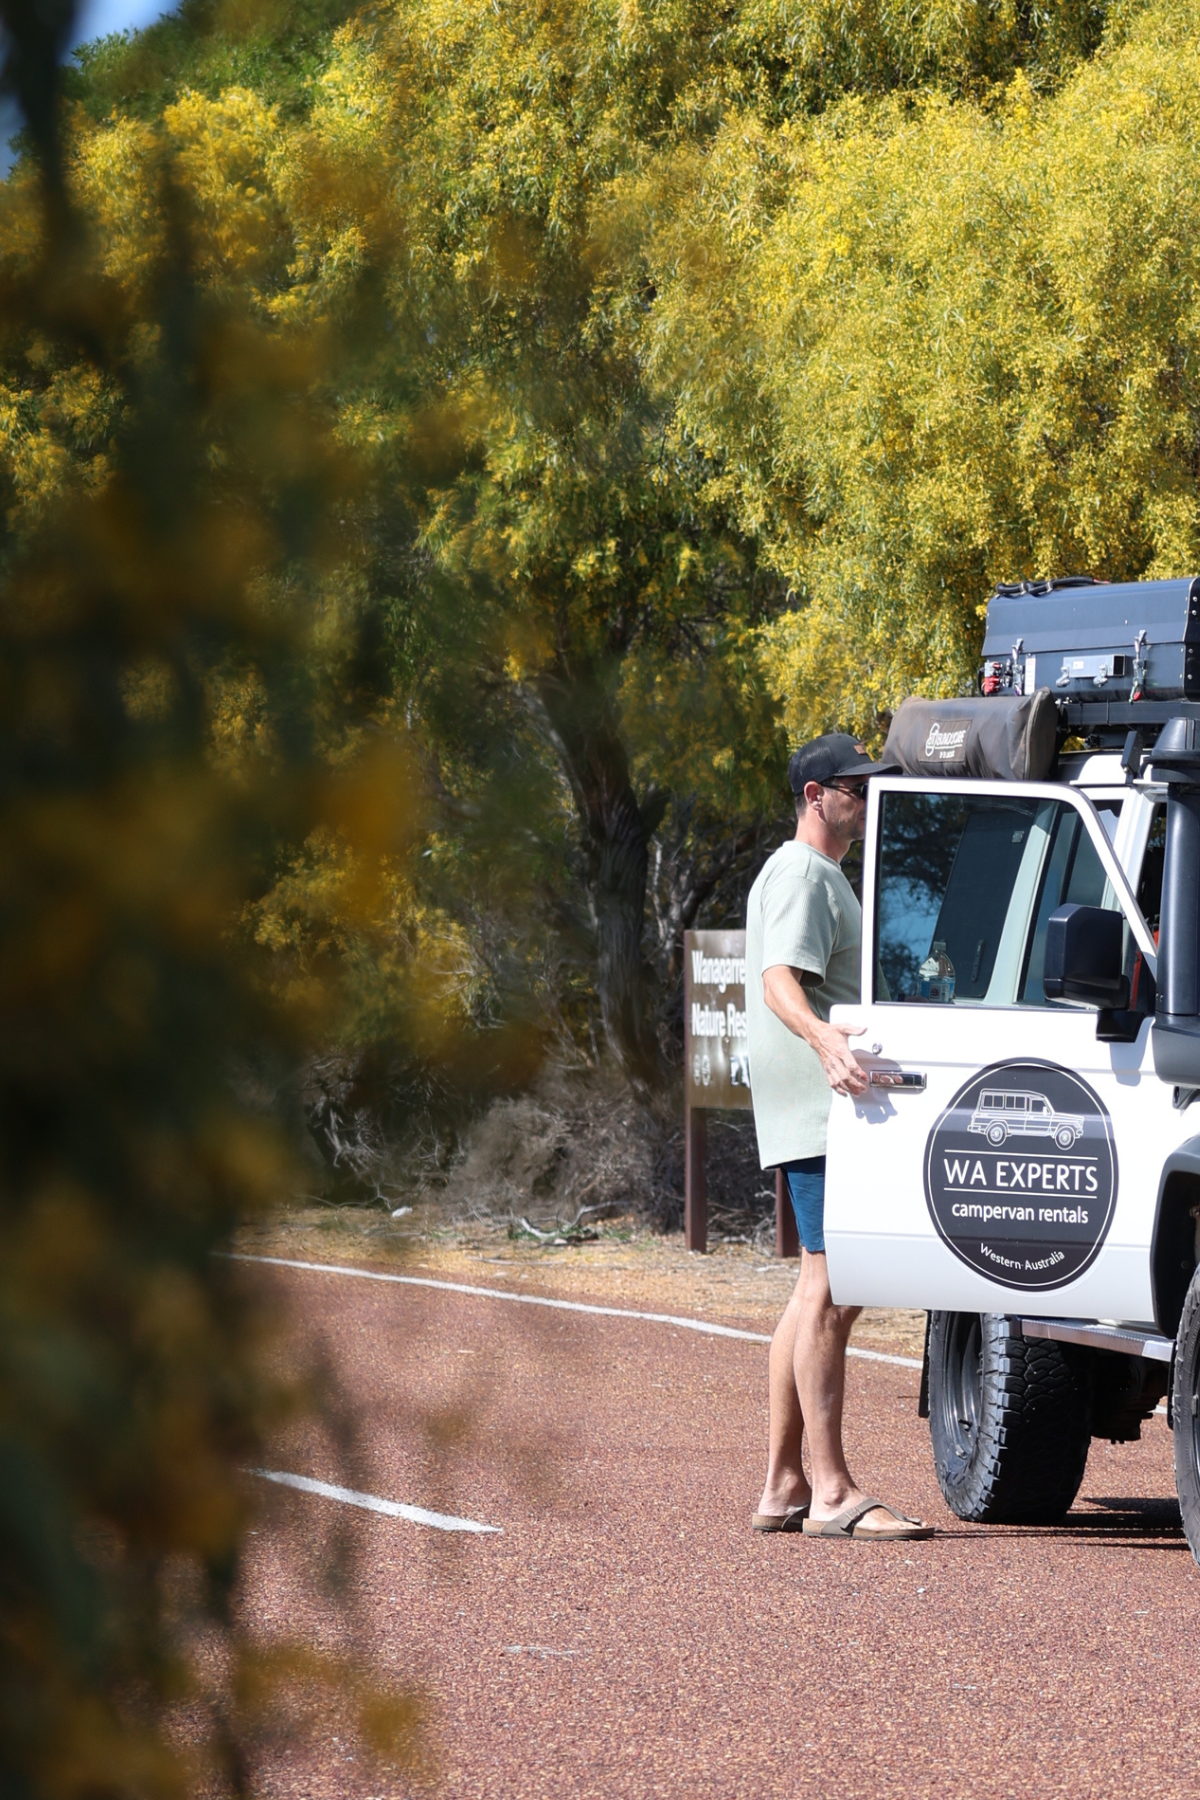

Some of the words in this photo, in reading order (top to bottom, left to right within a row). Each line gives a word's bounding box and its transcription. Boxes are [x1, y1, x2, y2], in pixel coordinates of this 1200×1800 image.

[691, 1002, 727, 1037] Nature
[943, 1158, 987, 1186] WA
[996, 1161, 1098, 1192] EXPERTS
[951, 1203, 1035, 1222] campervan
[1038, 1205, 1089, 1224] rentals
[980, 1242, 1021, 1270] Western
[1024, 1251, 1065, 1270] Australia
